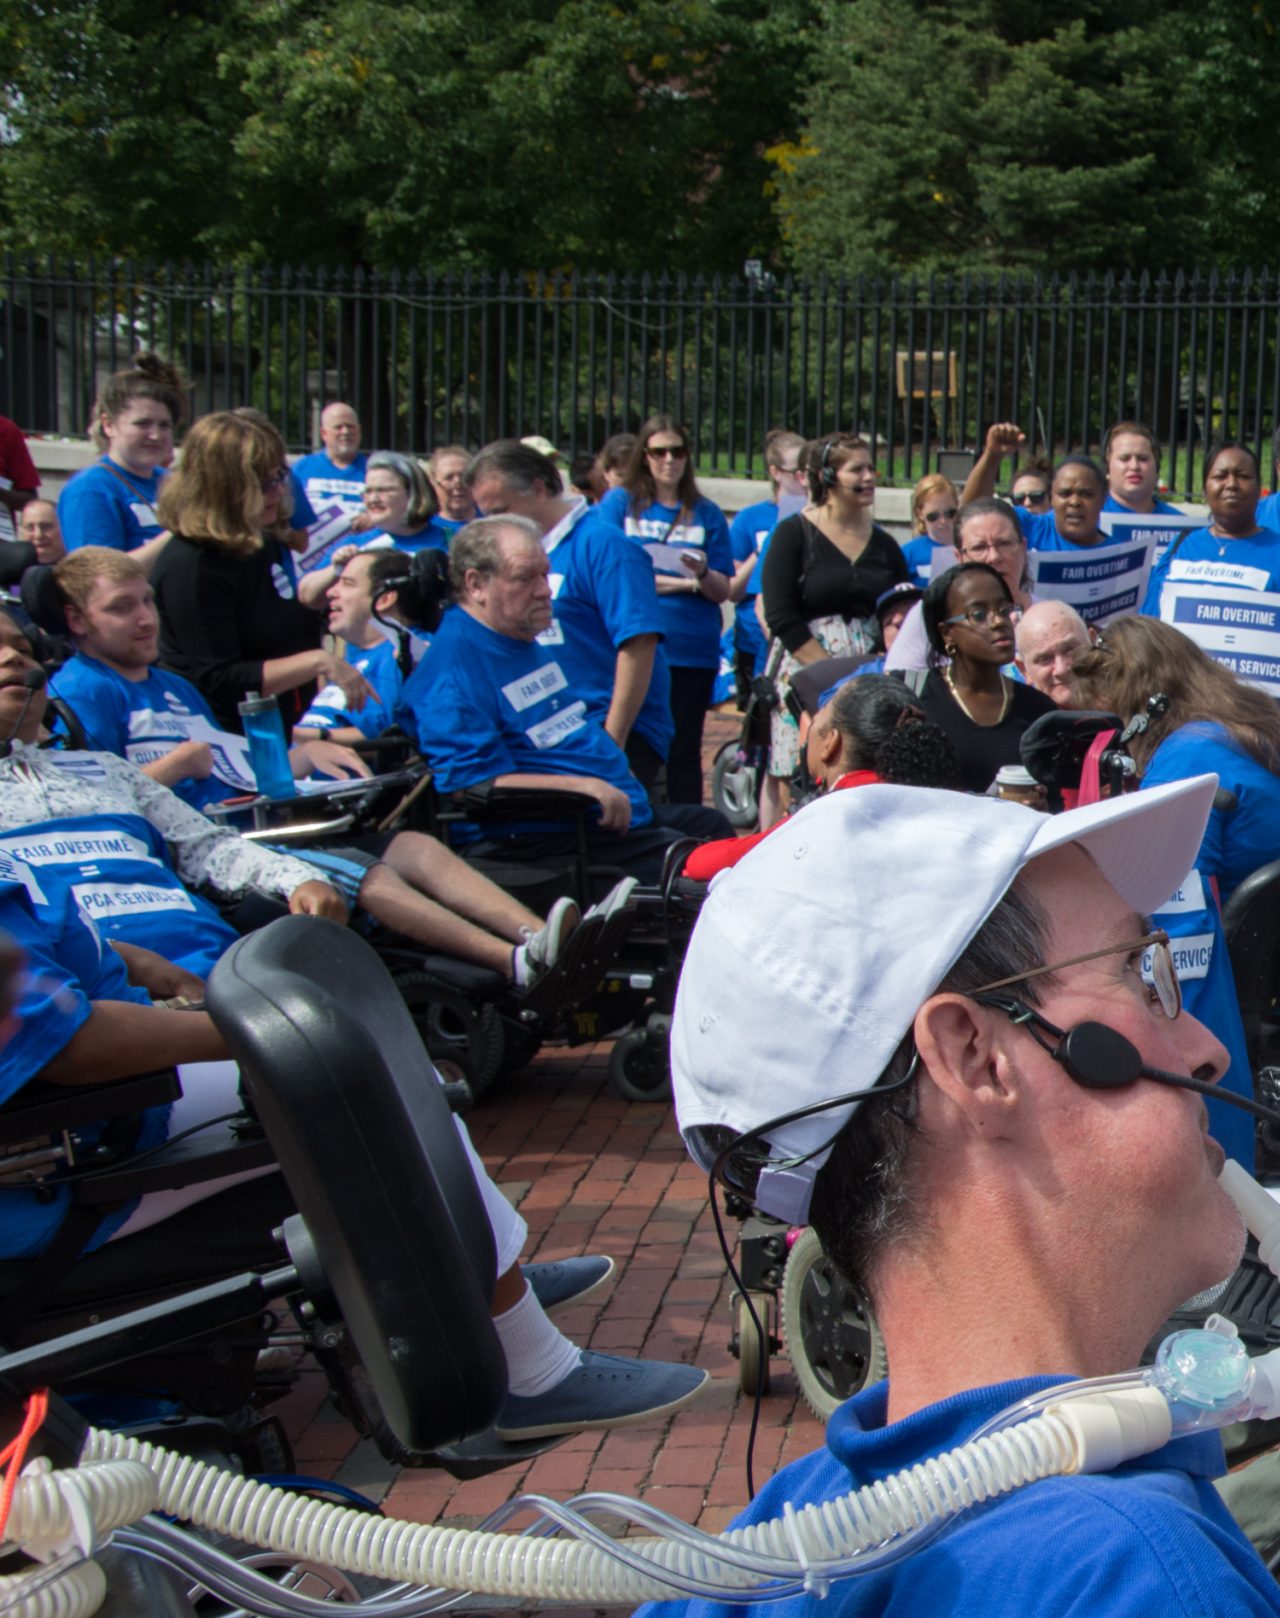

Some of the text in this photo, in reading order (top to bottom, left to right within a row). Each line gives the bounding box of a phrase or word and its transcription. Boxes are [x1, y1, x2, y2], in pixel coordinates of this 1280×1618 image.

[1132, 530, 1151, 542] FAIR
[1062, 558, 1129, 580] FAIR OVERTIME
[1185, 566, 1245, 580] FAIR OVERTIME
[1083, 592, 1135, 622] PCA SERVICES
[1197, 605, 1275, 626] FAIR OVERTIME
[13, 839, 133, 859] FAIR OVERTIME
[82, 888, 185, 910] PCA SERVICES
